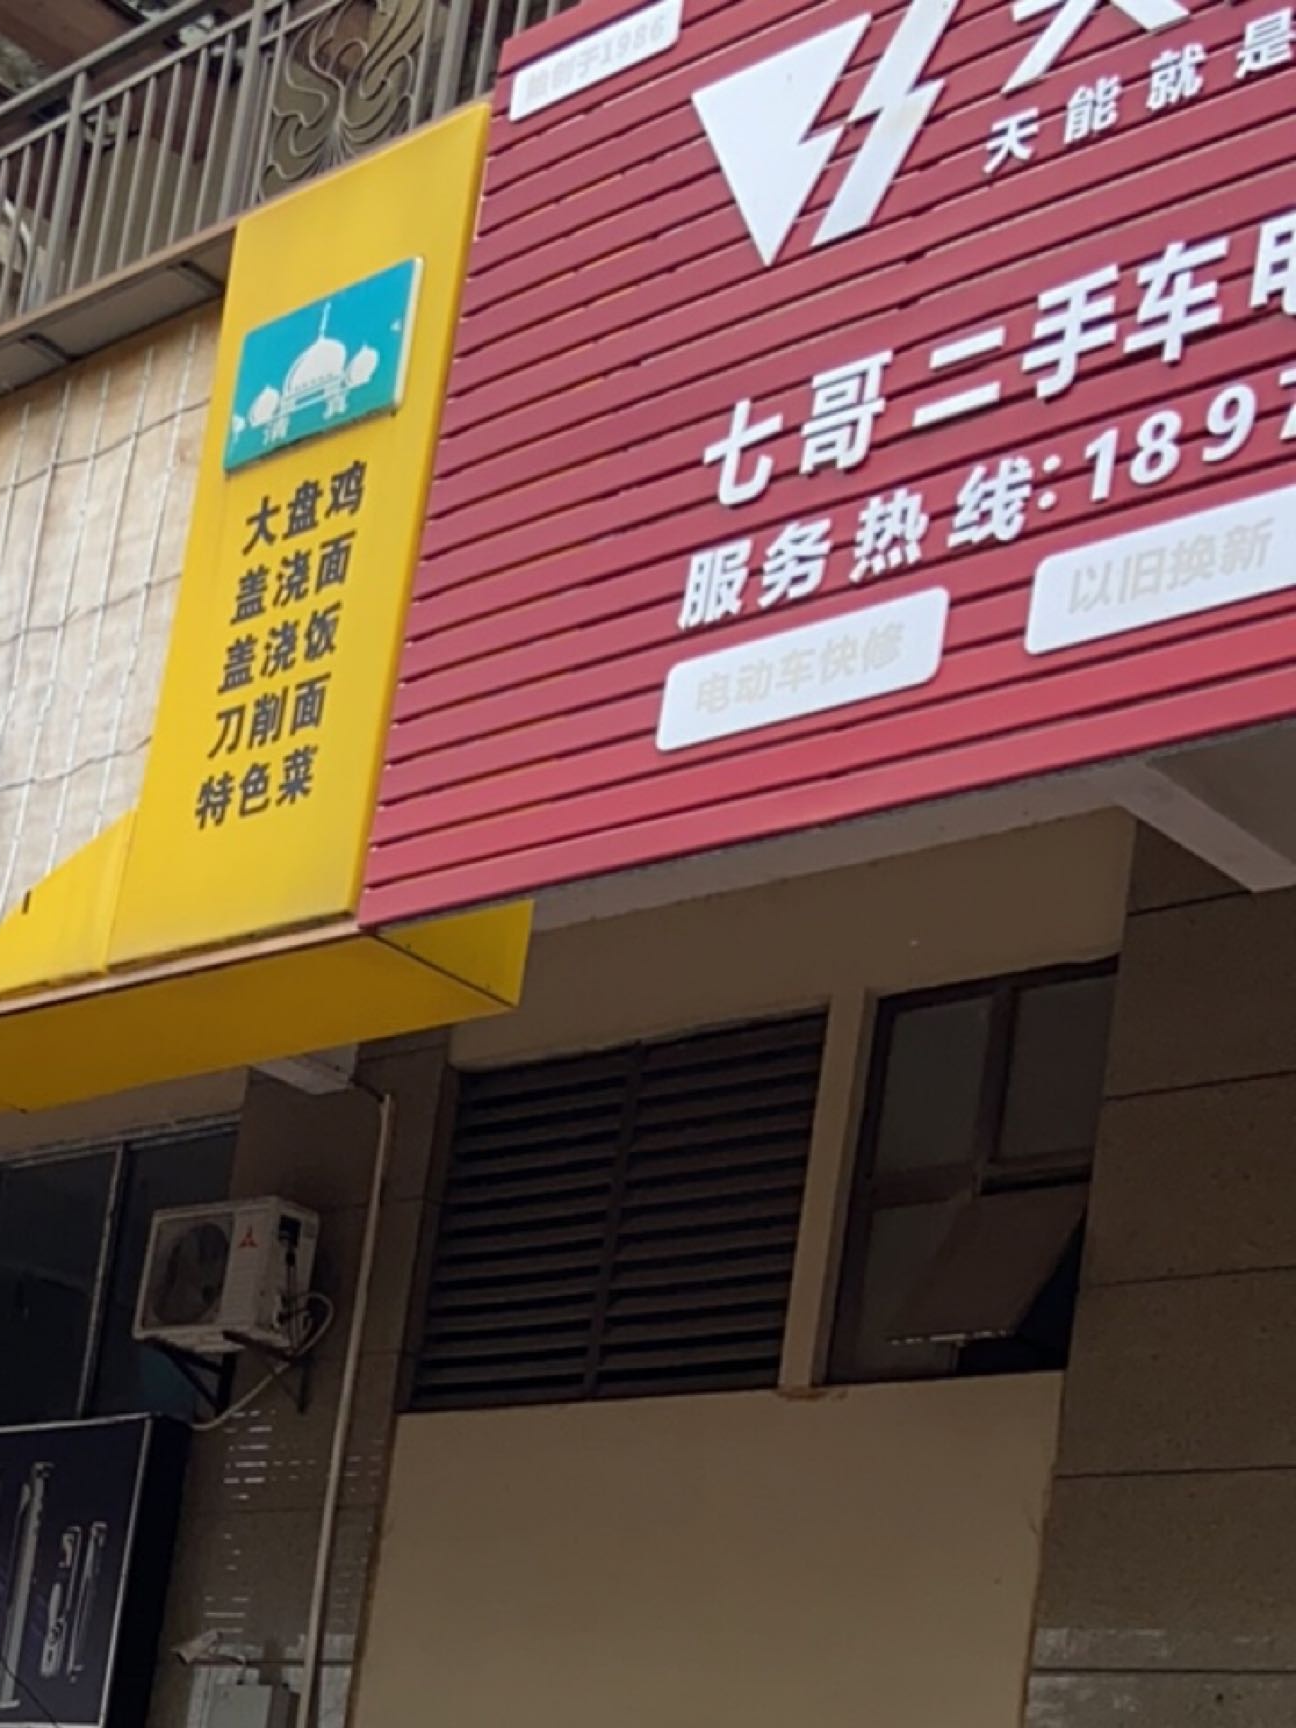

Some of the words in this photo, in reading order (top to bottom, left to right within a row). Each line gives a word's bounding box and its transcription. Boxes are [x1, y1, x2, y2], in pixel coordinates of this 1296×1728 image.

[983, 7, 1295, 174] 天能就是
[241, 460, 368, 555] 大盘鸡
[230, 530, 357, 625] 盖浇面
[1067, 517, 1277, 615] 以旧换新
[217, 602, 343, 694] 盖浇饭
[695, 622, 906, 716] 电动车快修
[207, 672, 332, 759] 刀削面
[195, 745, 319, 830] 特色菜
